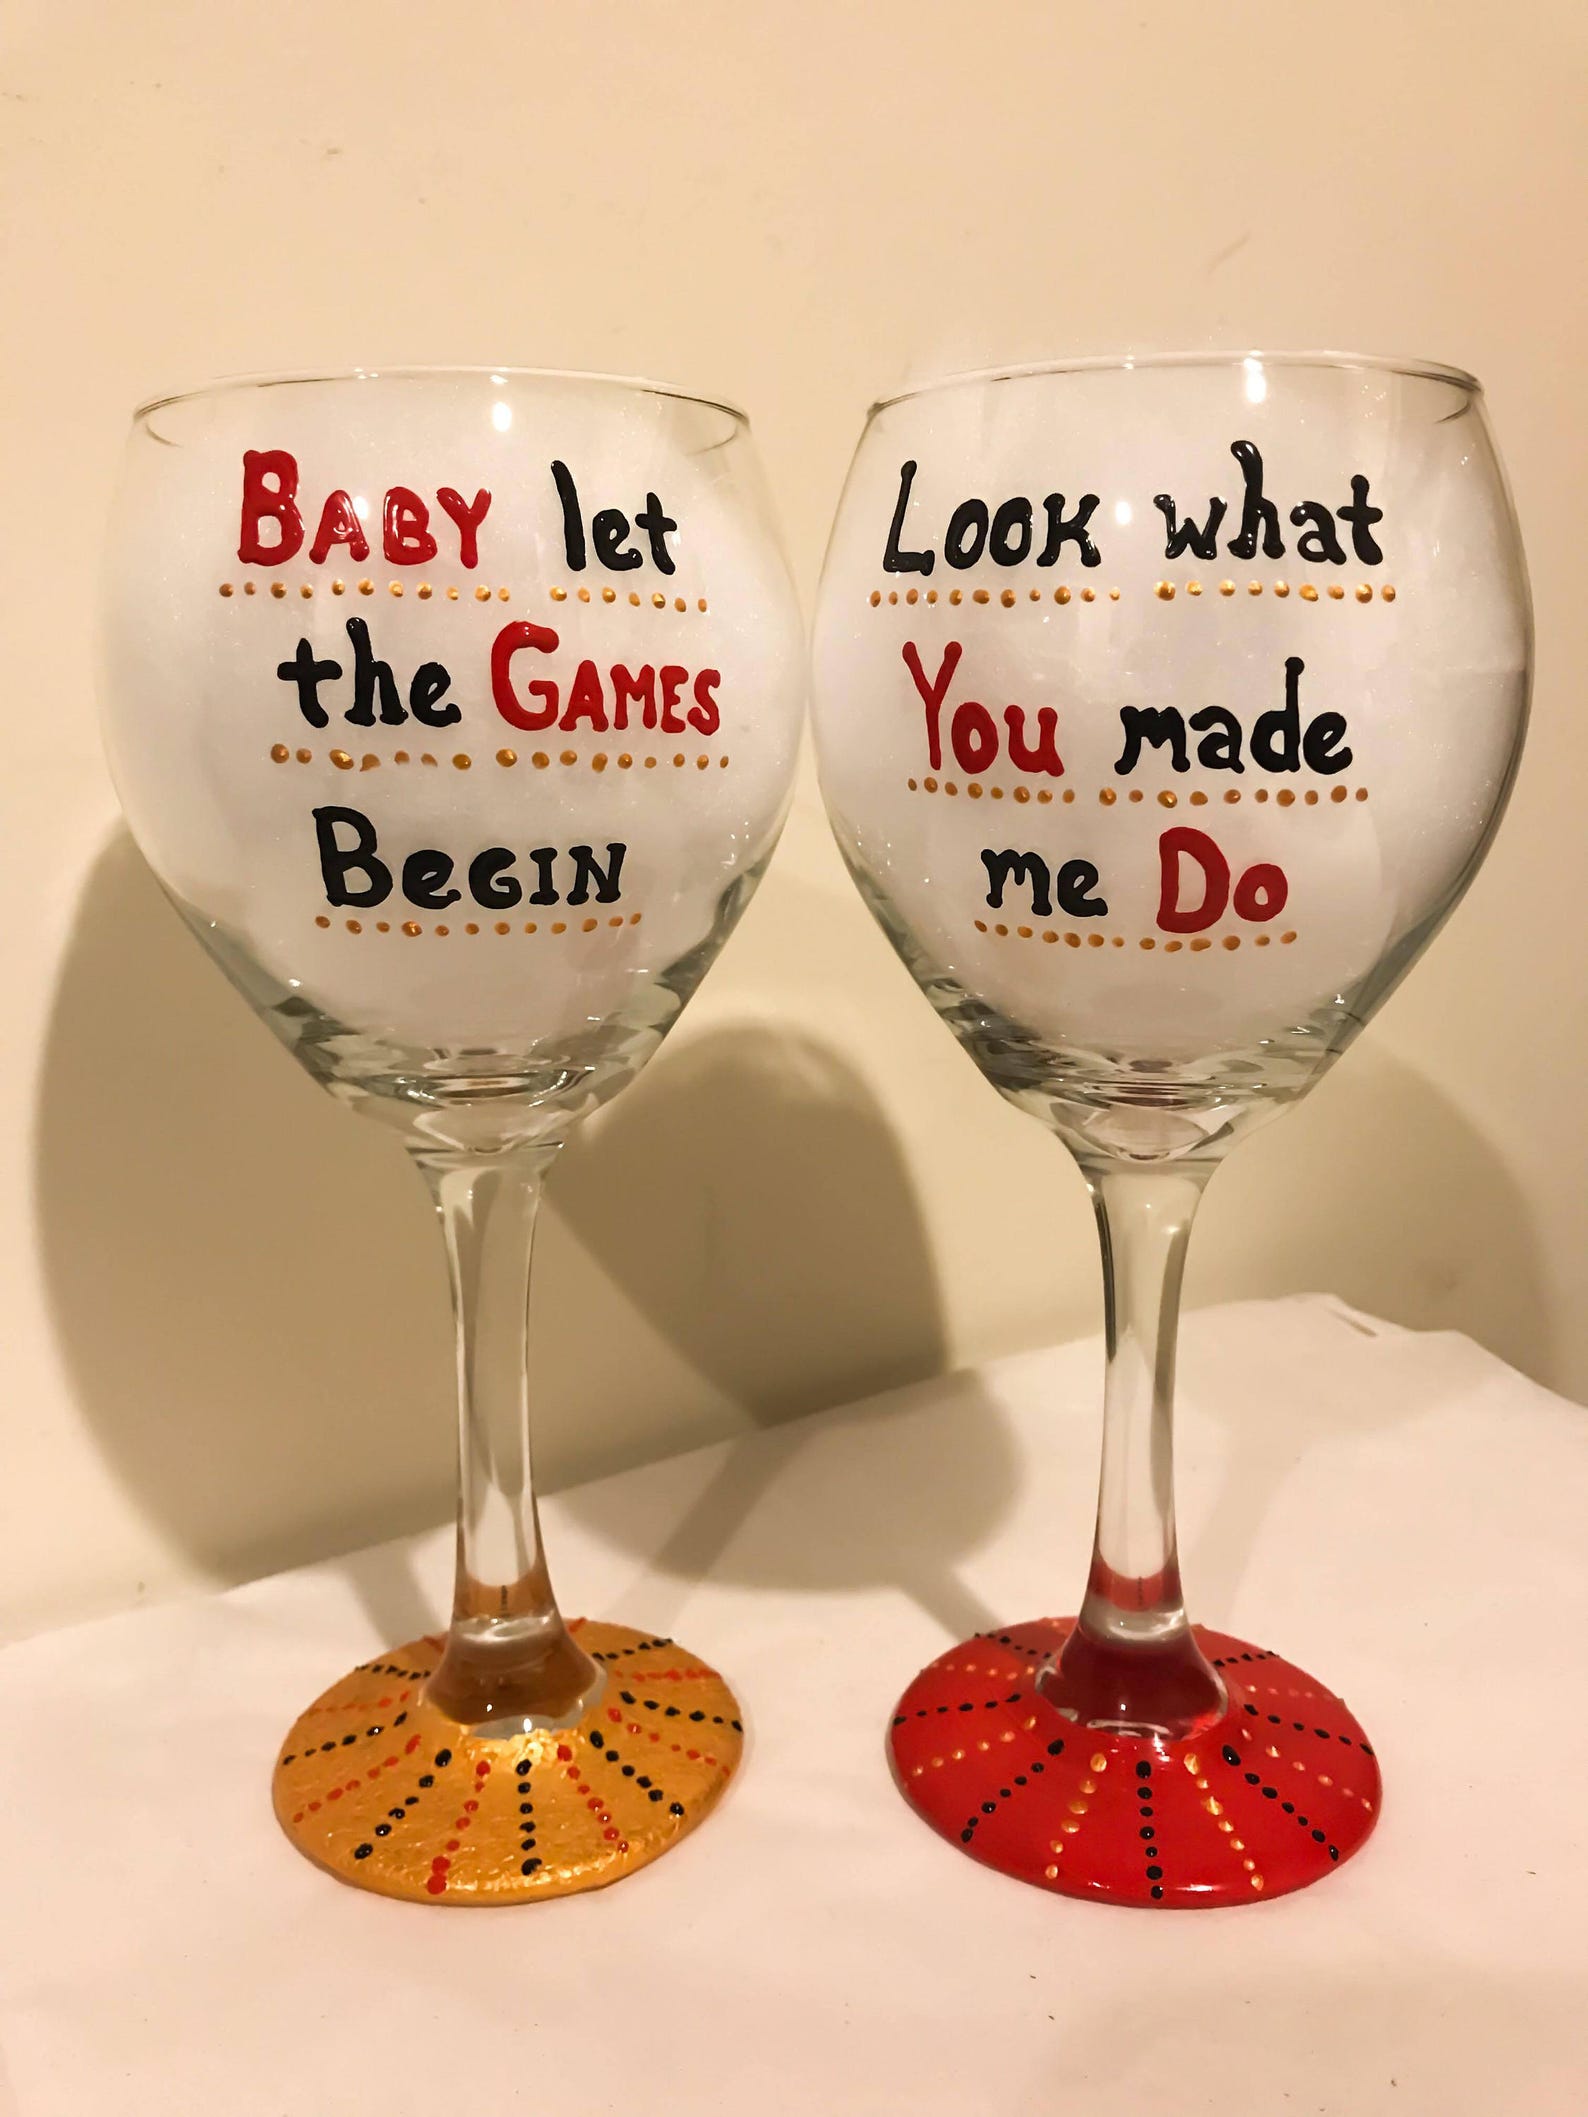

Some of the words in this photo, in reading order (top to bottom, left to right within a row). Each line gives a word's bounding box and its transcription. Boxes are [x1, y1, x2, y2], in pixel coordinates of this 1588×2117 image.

[551, 461, 677, 575] let
[1154, 441, 1383, 565] what
[277, 617, 461, 728] the
[491, 621, 720, 735] GAMES
[903, 642, 1064, 777] You
[1114, 657, 1352, 775] made
[981, 849, 1108, 917] me
[1157, 827, 1287, 933] Do
